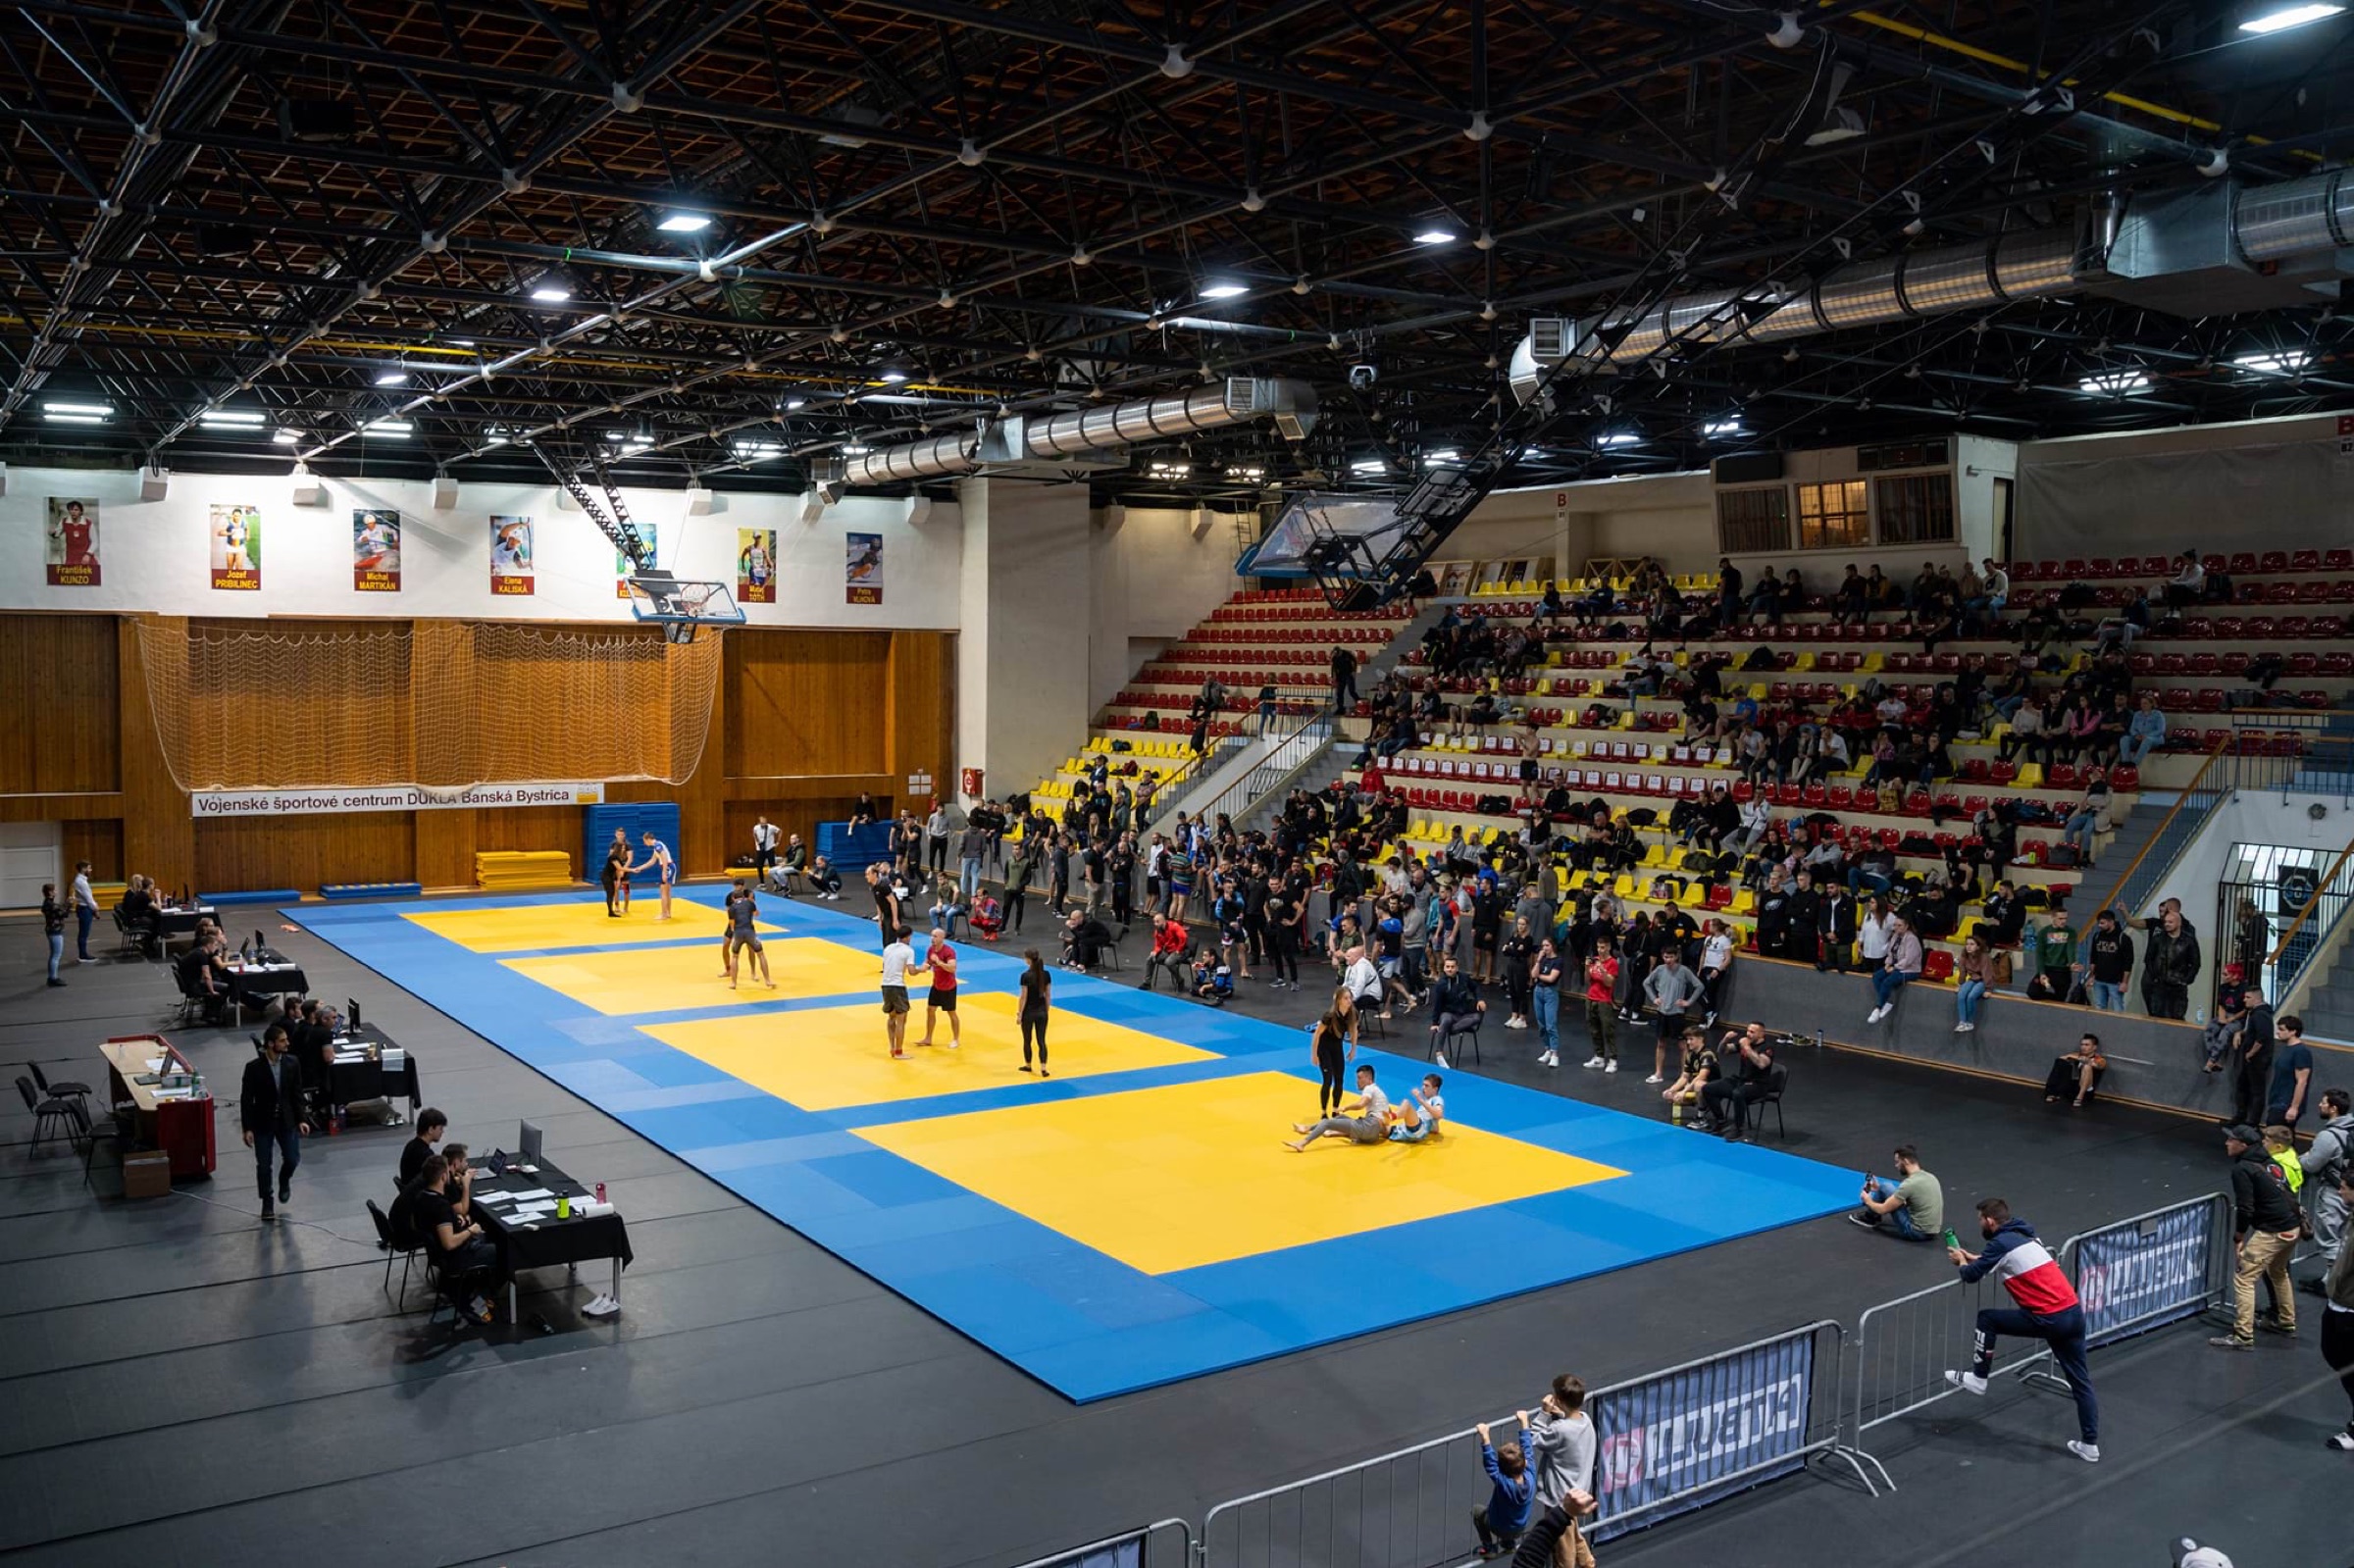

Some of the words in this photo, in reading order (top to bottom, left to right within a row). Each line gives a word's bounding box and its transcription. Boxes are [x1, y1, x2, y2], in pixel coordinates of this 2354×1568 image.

[1558, 493, 1566, 507] B
[60, 576, 89, 584] KUNZO
[215, 579, 258, 589] PRIBILINEC
[198, 796, 269, 814] Vojenské
[274, 795, 338, 812] športové
[343, 794, 403, 807] centrum
[461, 790, 512, 804] Banská
[516, 789, 570, 804] Bystrica
